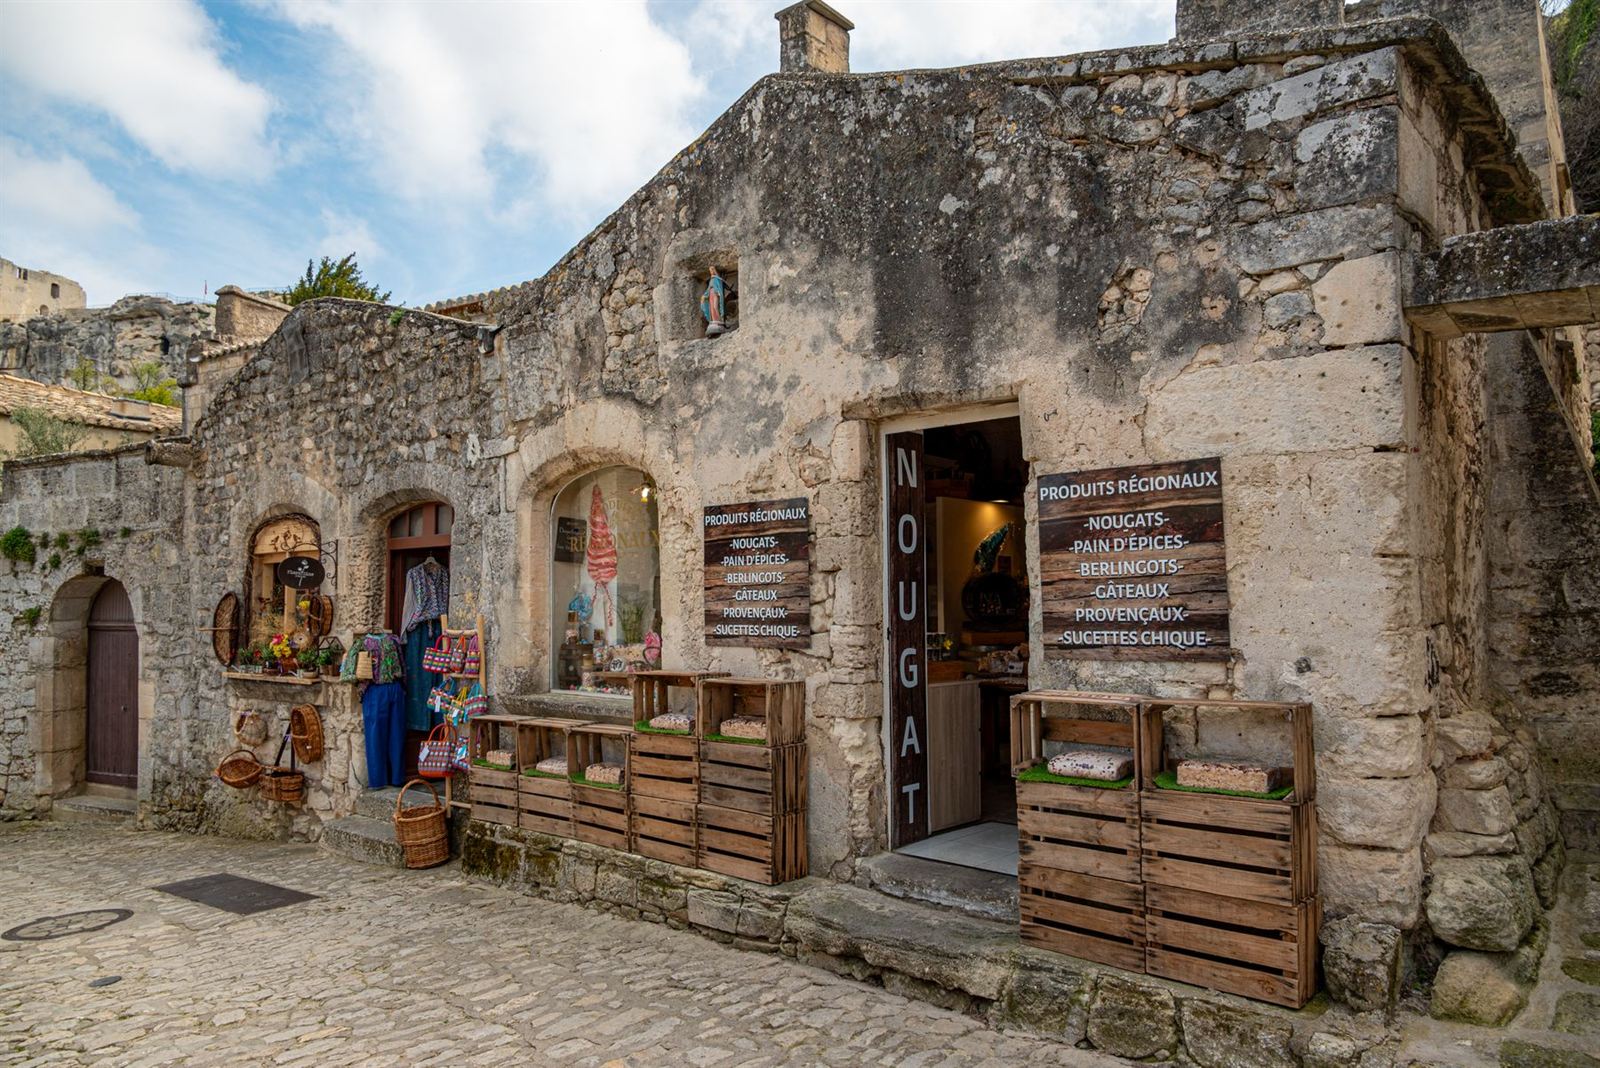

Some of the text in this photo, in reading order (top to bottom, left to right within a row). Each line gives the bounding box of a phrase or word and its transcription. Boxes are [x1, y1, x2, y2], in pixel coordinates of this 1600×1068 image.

[1040, 470, 1218, 501] PRODUITS RÉGIONAUX
[705, 507, 806, 526] PRODUITS RÉGIONAUX
[896, 447, 921, 824] NOUGAT
